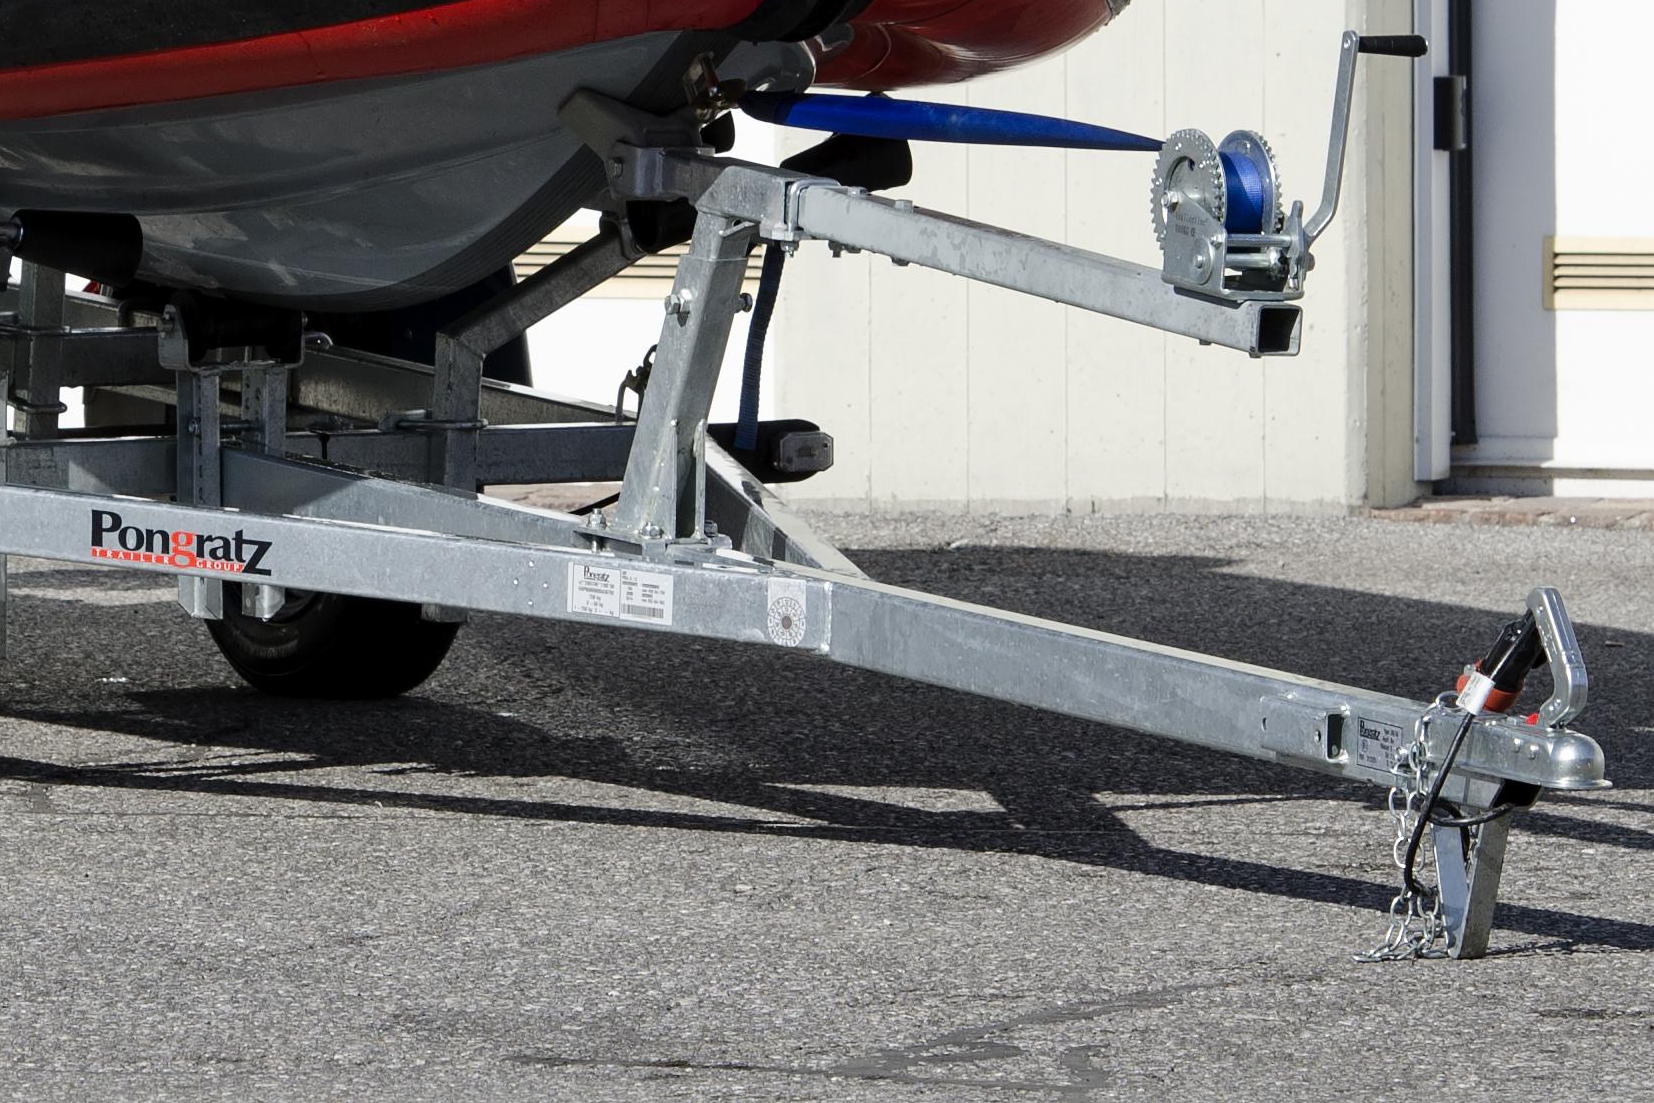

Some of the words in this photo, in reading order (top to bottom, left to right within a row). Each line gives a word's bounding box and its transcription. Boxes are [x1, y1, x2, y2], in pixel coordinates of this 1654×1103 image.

[91, 509, 273, 576] Pongratz
[95, 548, 170, 564] TRAILER
[195, 559, 240, 572] GROUP
